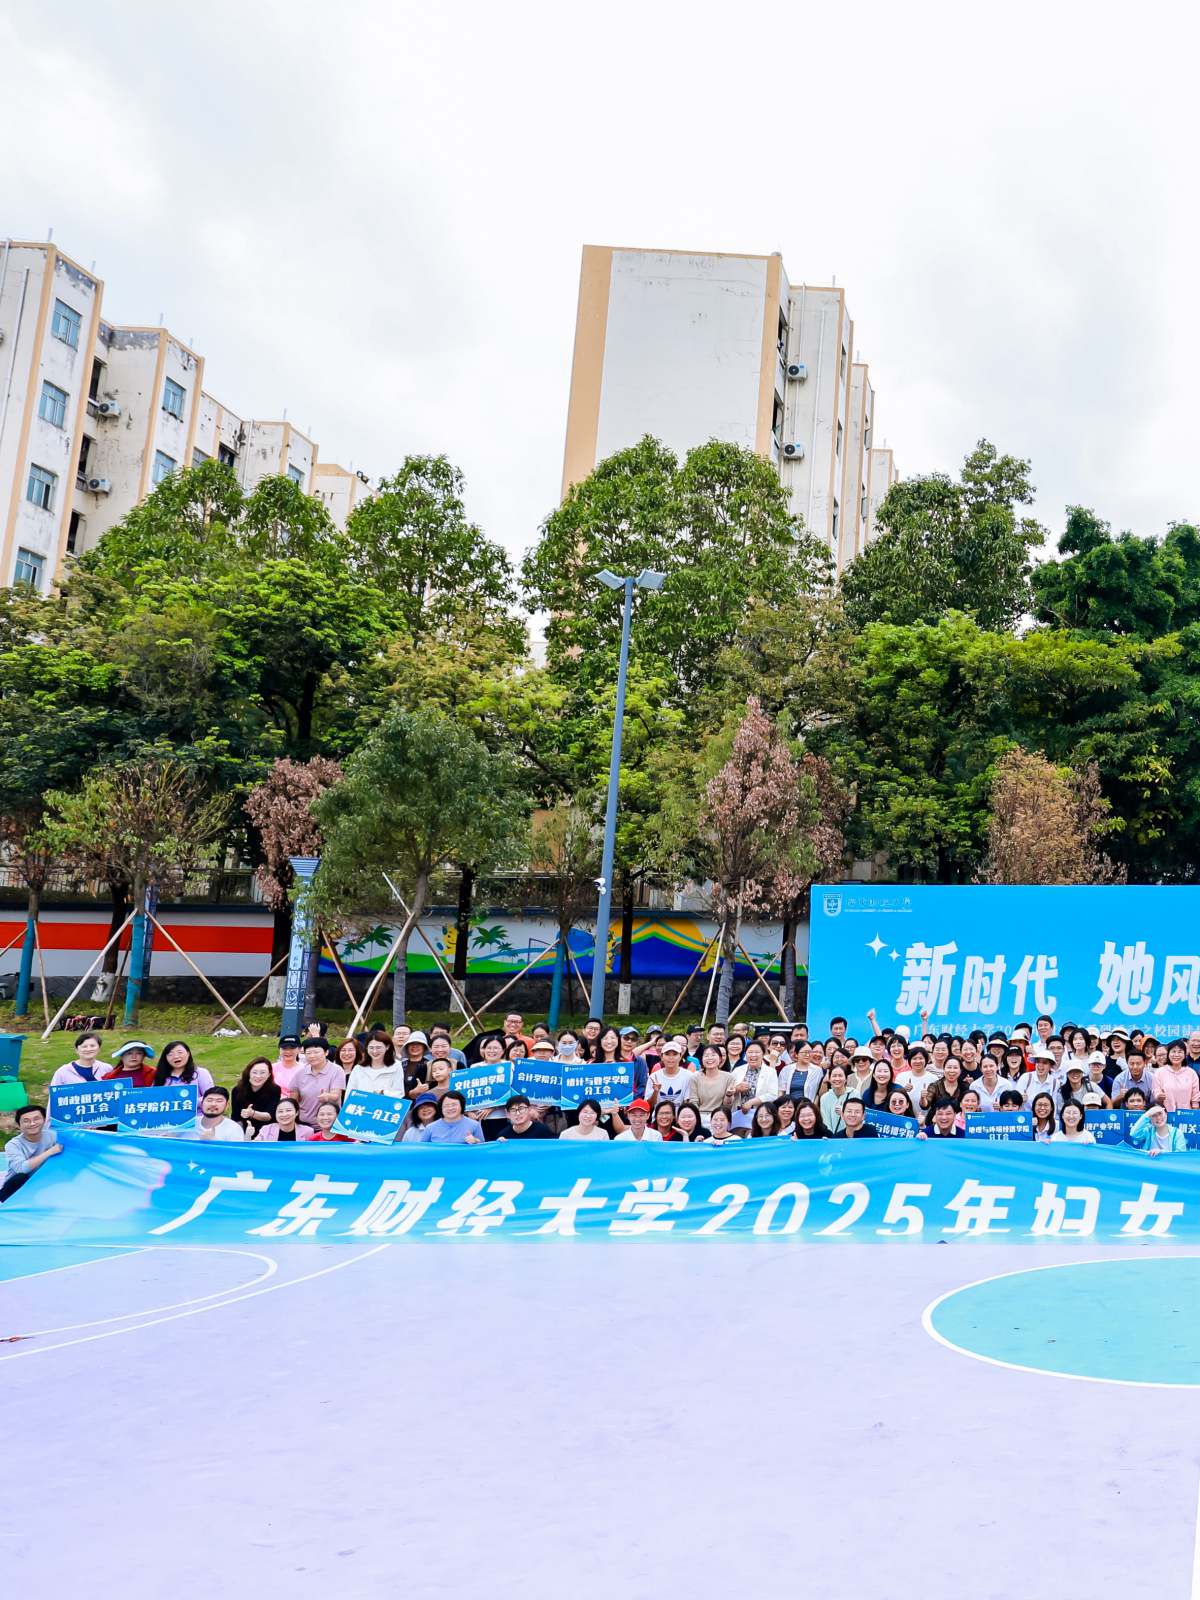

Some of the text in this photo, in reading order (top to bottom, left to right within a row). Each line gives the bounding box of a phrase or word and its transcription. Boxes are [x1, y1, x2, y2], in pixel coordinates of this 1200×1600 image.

[896, 940, 1059, 1016] 新时代
[517, 1072, 562, 1085] 会计学院分工
[467, 1087, 492, 1098] 分工会
[585, 1086, 611, 1096] 分工会
[75, 1102, 110, 1115] 分工会
[124, 1099, 193, 1114] 法学院分工会
